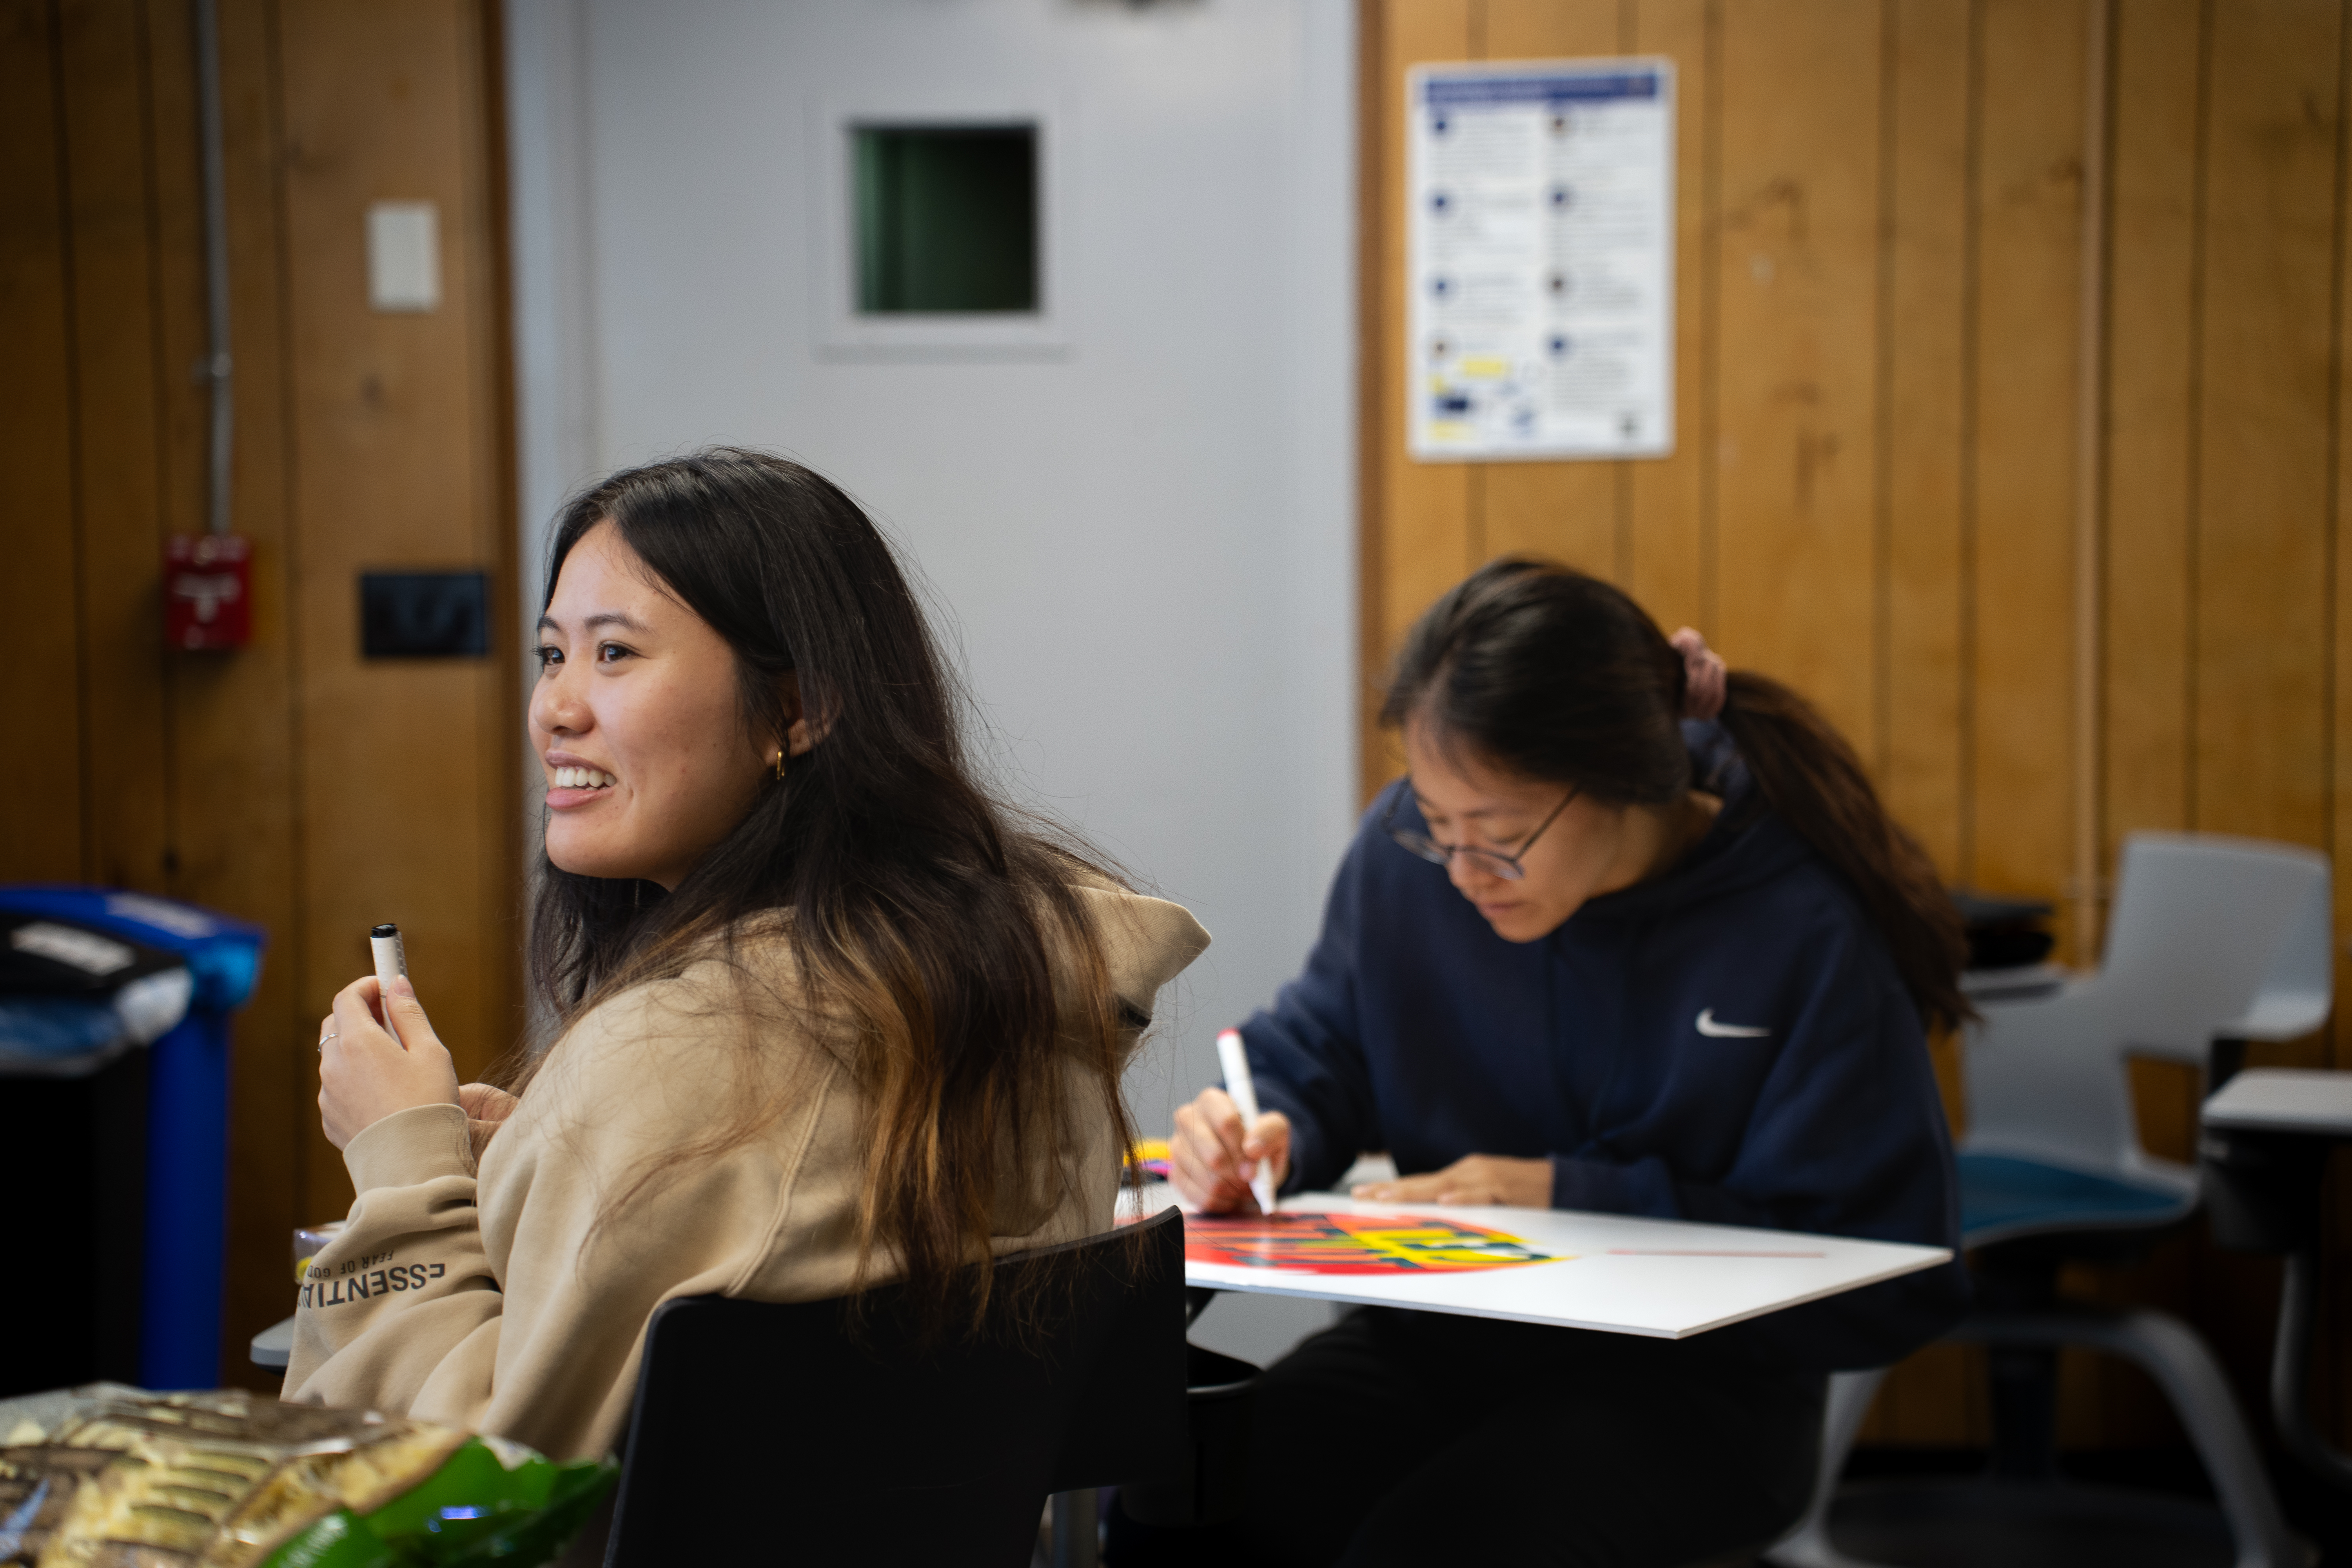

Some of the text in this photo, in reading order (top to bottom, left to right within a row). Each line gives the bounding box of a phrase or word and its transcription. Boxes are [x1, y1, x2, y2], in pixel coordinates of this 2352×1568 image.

[307, 1250, 394, 1278] FEAR OF GOD
[297, 1263, 445, 1308] ESSENTIA
